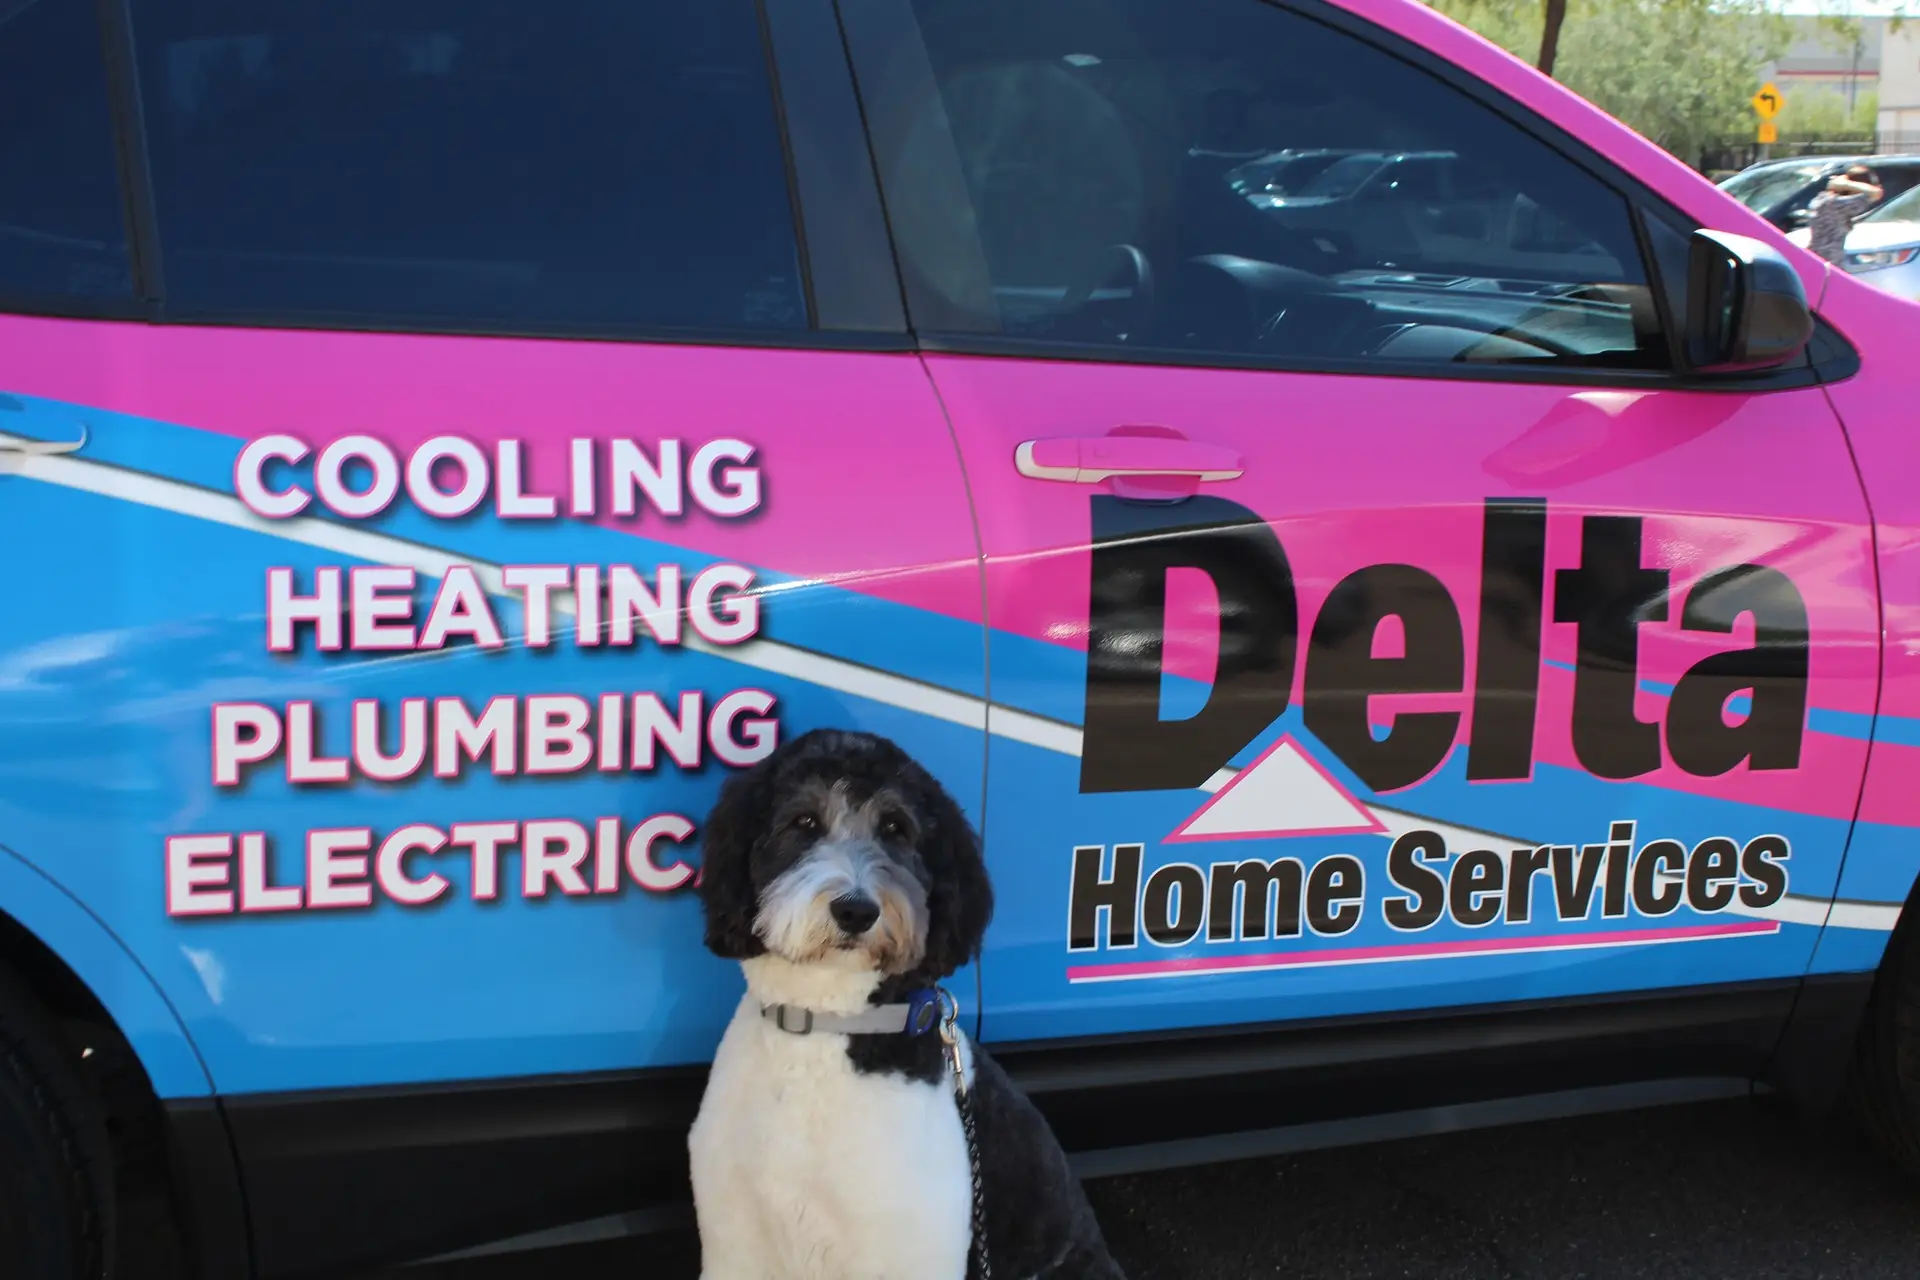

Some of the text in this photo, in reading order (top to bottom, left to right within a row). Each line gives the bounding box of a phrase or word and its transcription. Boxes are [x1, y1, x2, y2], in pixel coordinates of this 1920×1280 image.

[233, 434, 762, 519] COOLING
[265, 562, 762, 652] HEATING
[1079, 494, 1810, 795] Delta
[211, 688, 780, 786] PLUMBING
[165, 813, 703, 916] ELECTRIC
[1067, 819, 1792, 953] Home Services
